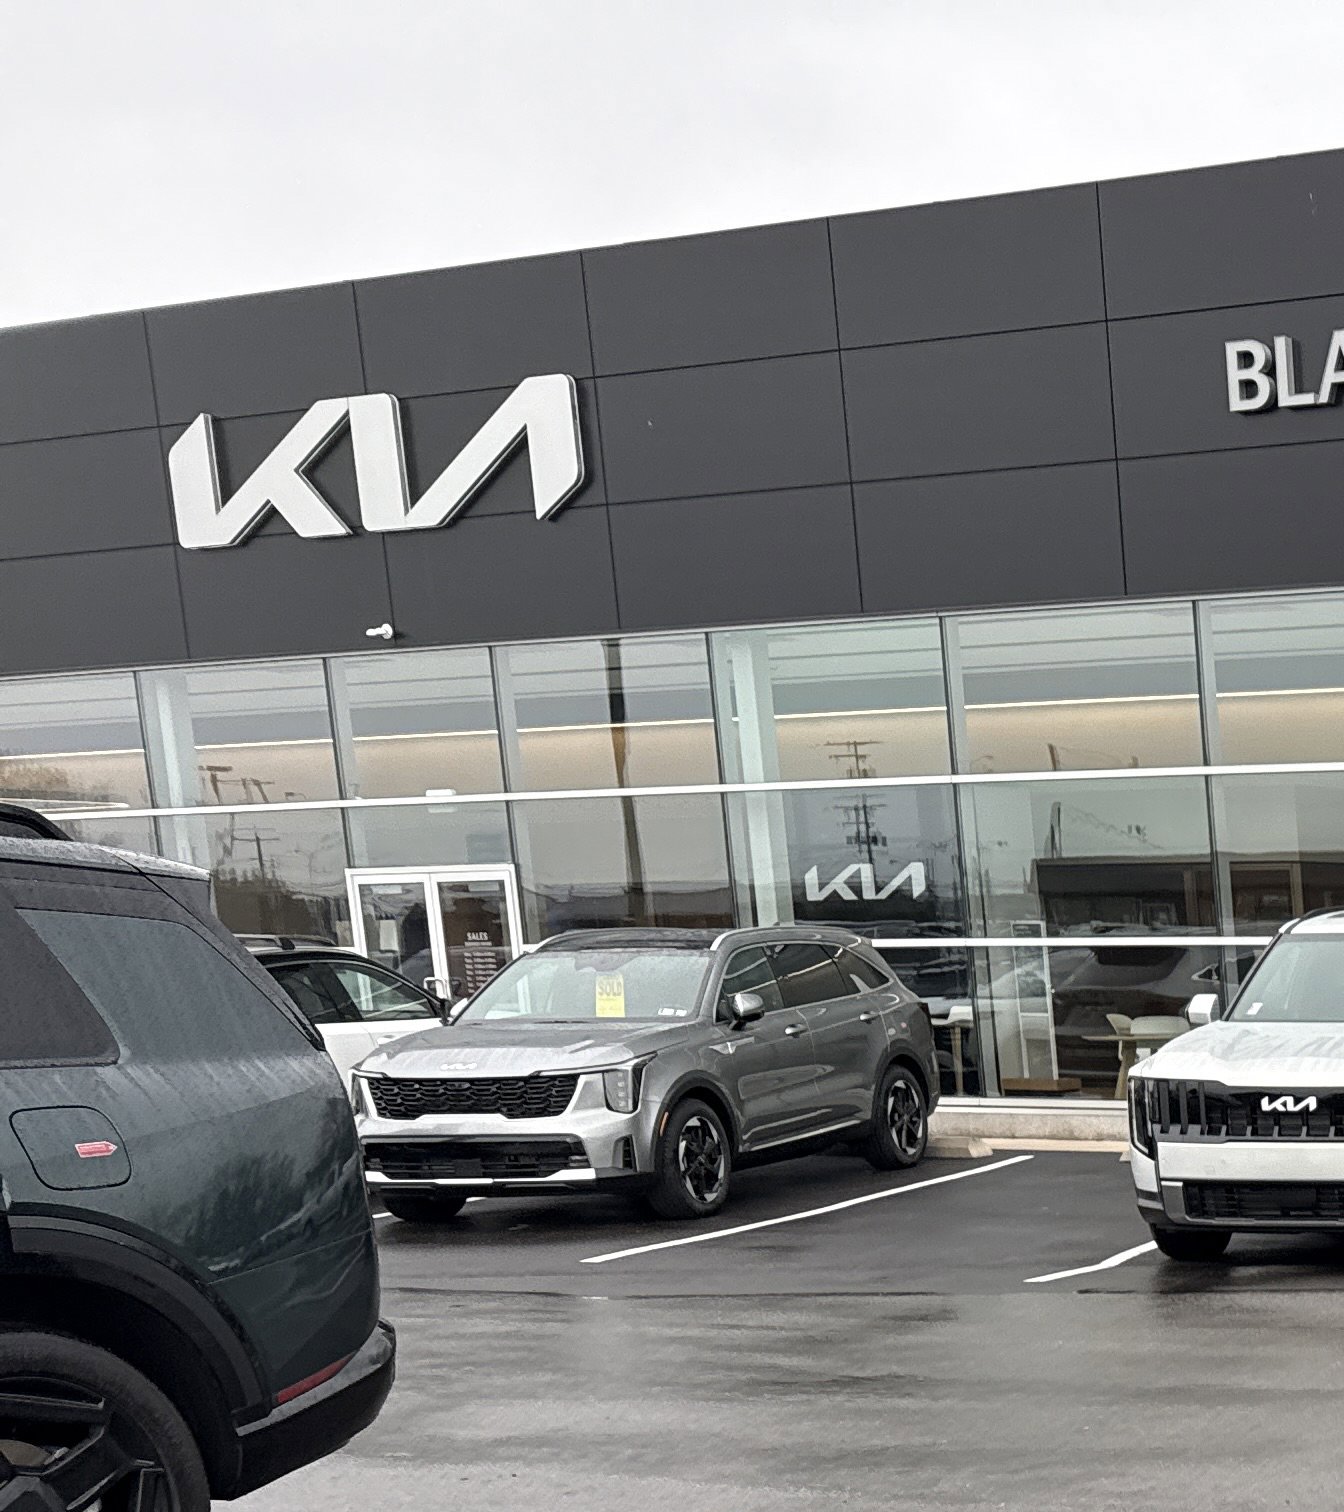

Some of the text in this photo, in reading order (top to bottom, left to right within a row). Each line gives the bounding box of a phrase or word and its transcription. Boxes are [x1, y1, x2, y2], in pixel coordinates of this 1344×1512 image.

[168, 373, 585, 549] KIA
[804, 861, 927, 902] KIA
[466, 931, 489, 941] SALES
[597, 981, 623, 997] SOLD
[1260, 1095, 1317, 1113] KIA
